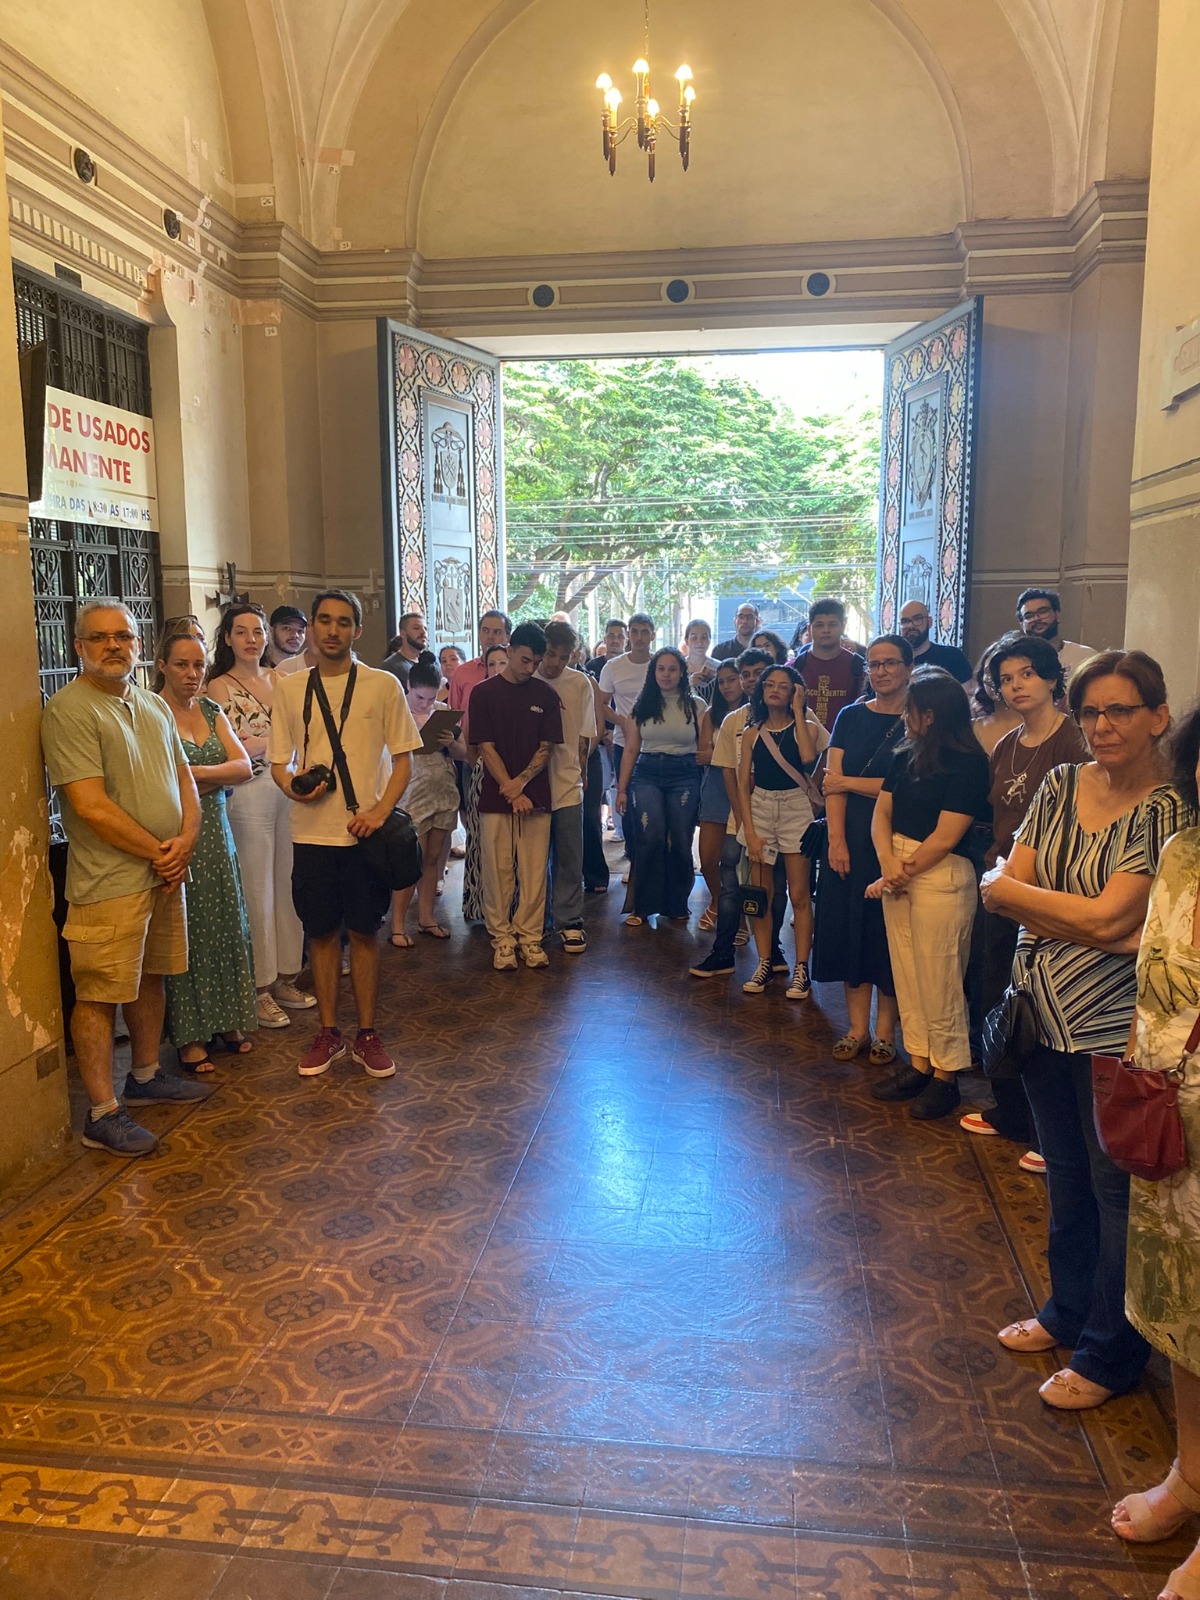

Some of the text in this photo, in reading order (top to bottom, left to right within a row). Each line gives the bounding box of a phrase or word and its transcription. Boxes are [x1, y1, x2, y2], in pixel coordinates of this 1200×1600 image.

[47, 402, 151, 454] DE USADOS
[69, 496, 86, 512] DAS
[110, 499, 120, 517] ÀS
[140, 509, 153, 522] HS.
